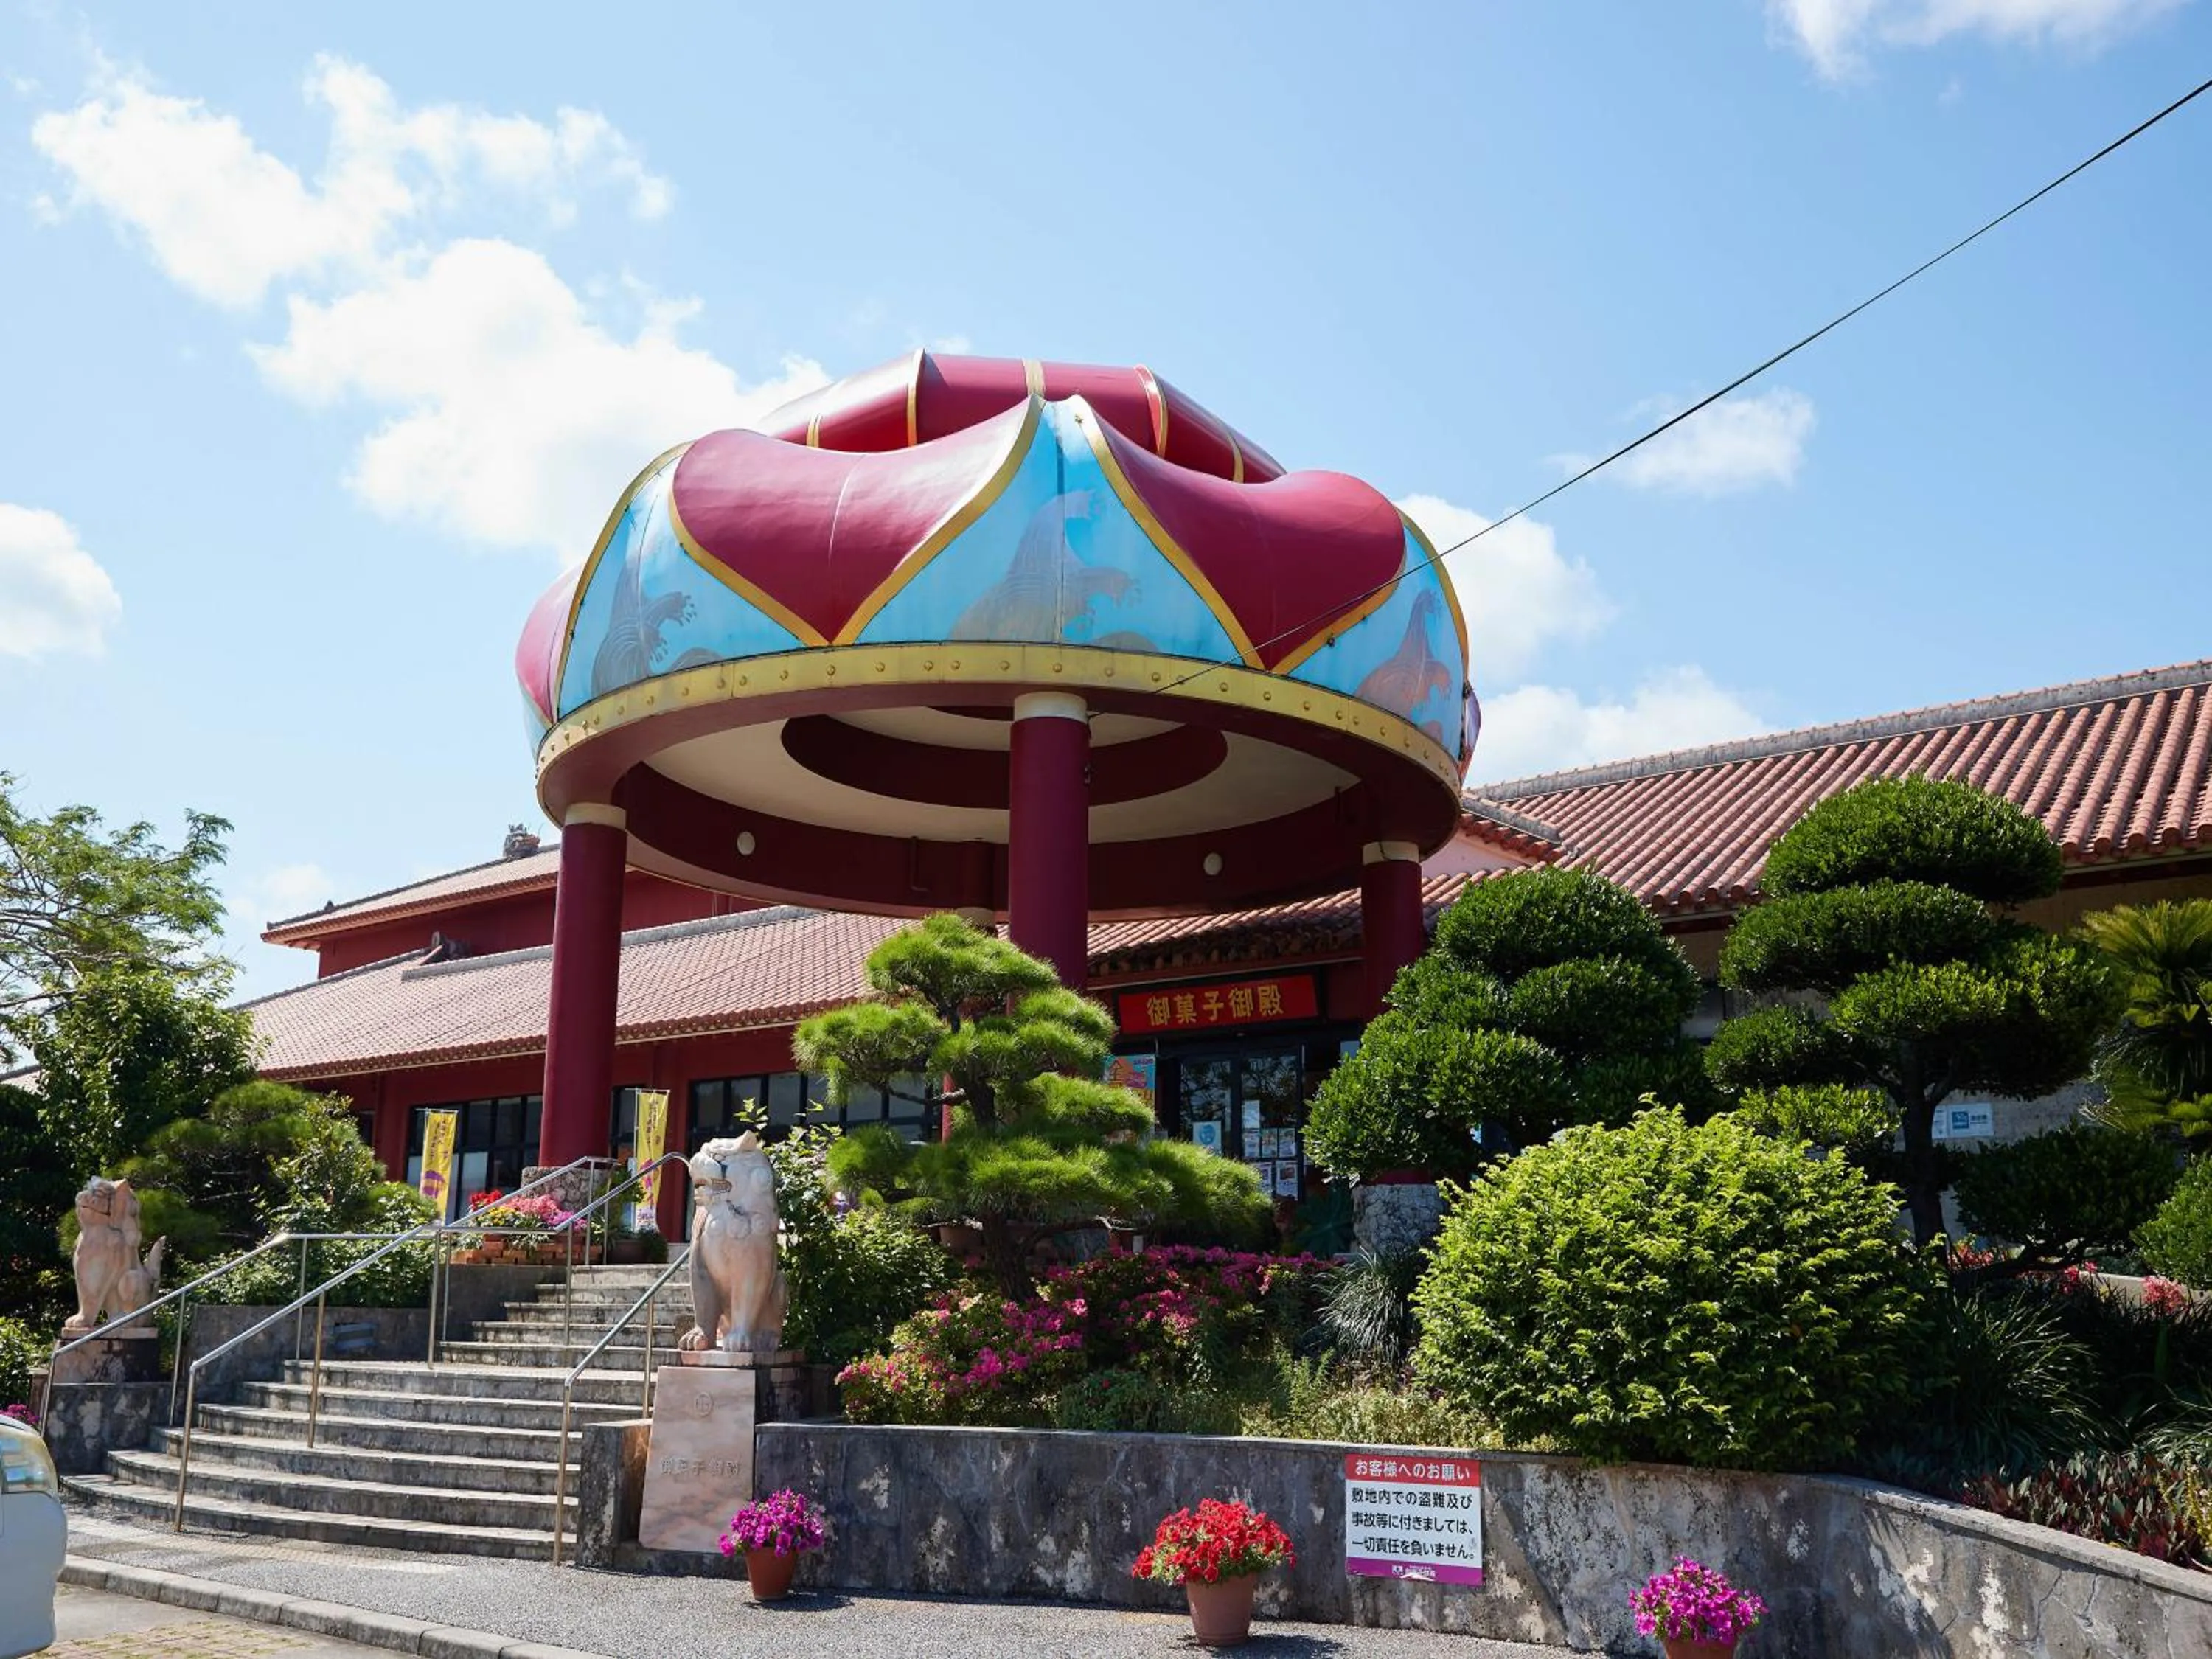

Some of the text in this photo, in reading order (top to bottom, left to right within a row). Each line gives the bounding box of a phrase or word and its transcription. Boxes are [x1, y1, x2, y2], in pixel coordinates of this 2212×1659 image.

[1147, 984, 1284, 1026] 御菓子御殿
[1356, 1459, 1470, 1481] お客様へのお願い
[1352, 1487, 1472, 1509] 敷地内での盗難及び
[1352, 1512, 1473, 1534] 事故等に付きましては、
[1352, 1537, 1475, 1559] 一切責任を負いません。
